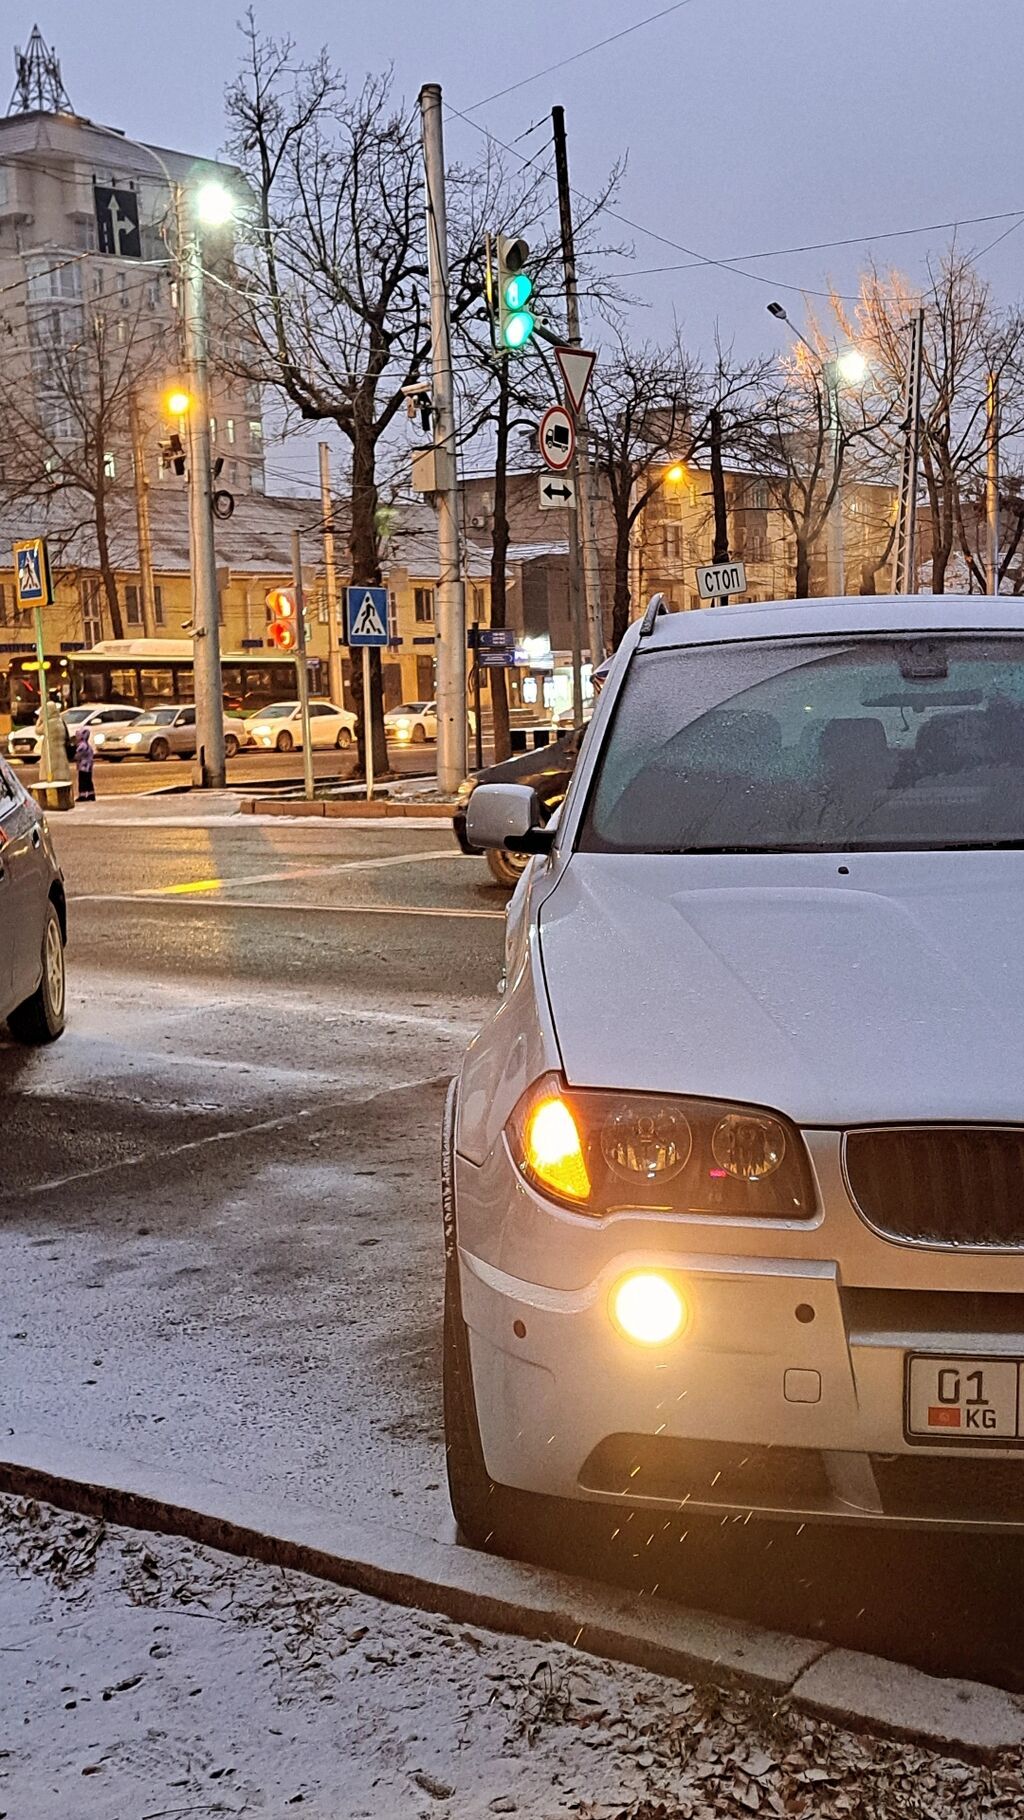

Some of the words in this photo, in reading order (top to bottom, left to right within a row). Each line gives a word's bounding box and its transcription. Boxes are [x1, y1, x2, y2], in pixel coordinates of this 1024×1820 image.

[704, 568, 740, 592] СТОП
[937, 1368, 989, 1405] 01
[965, 1408, 997, 1429] KG
